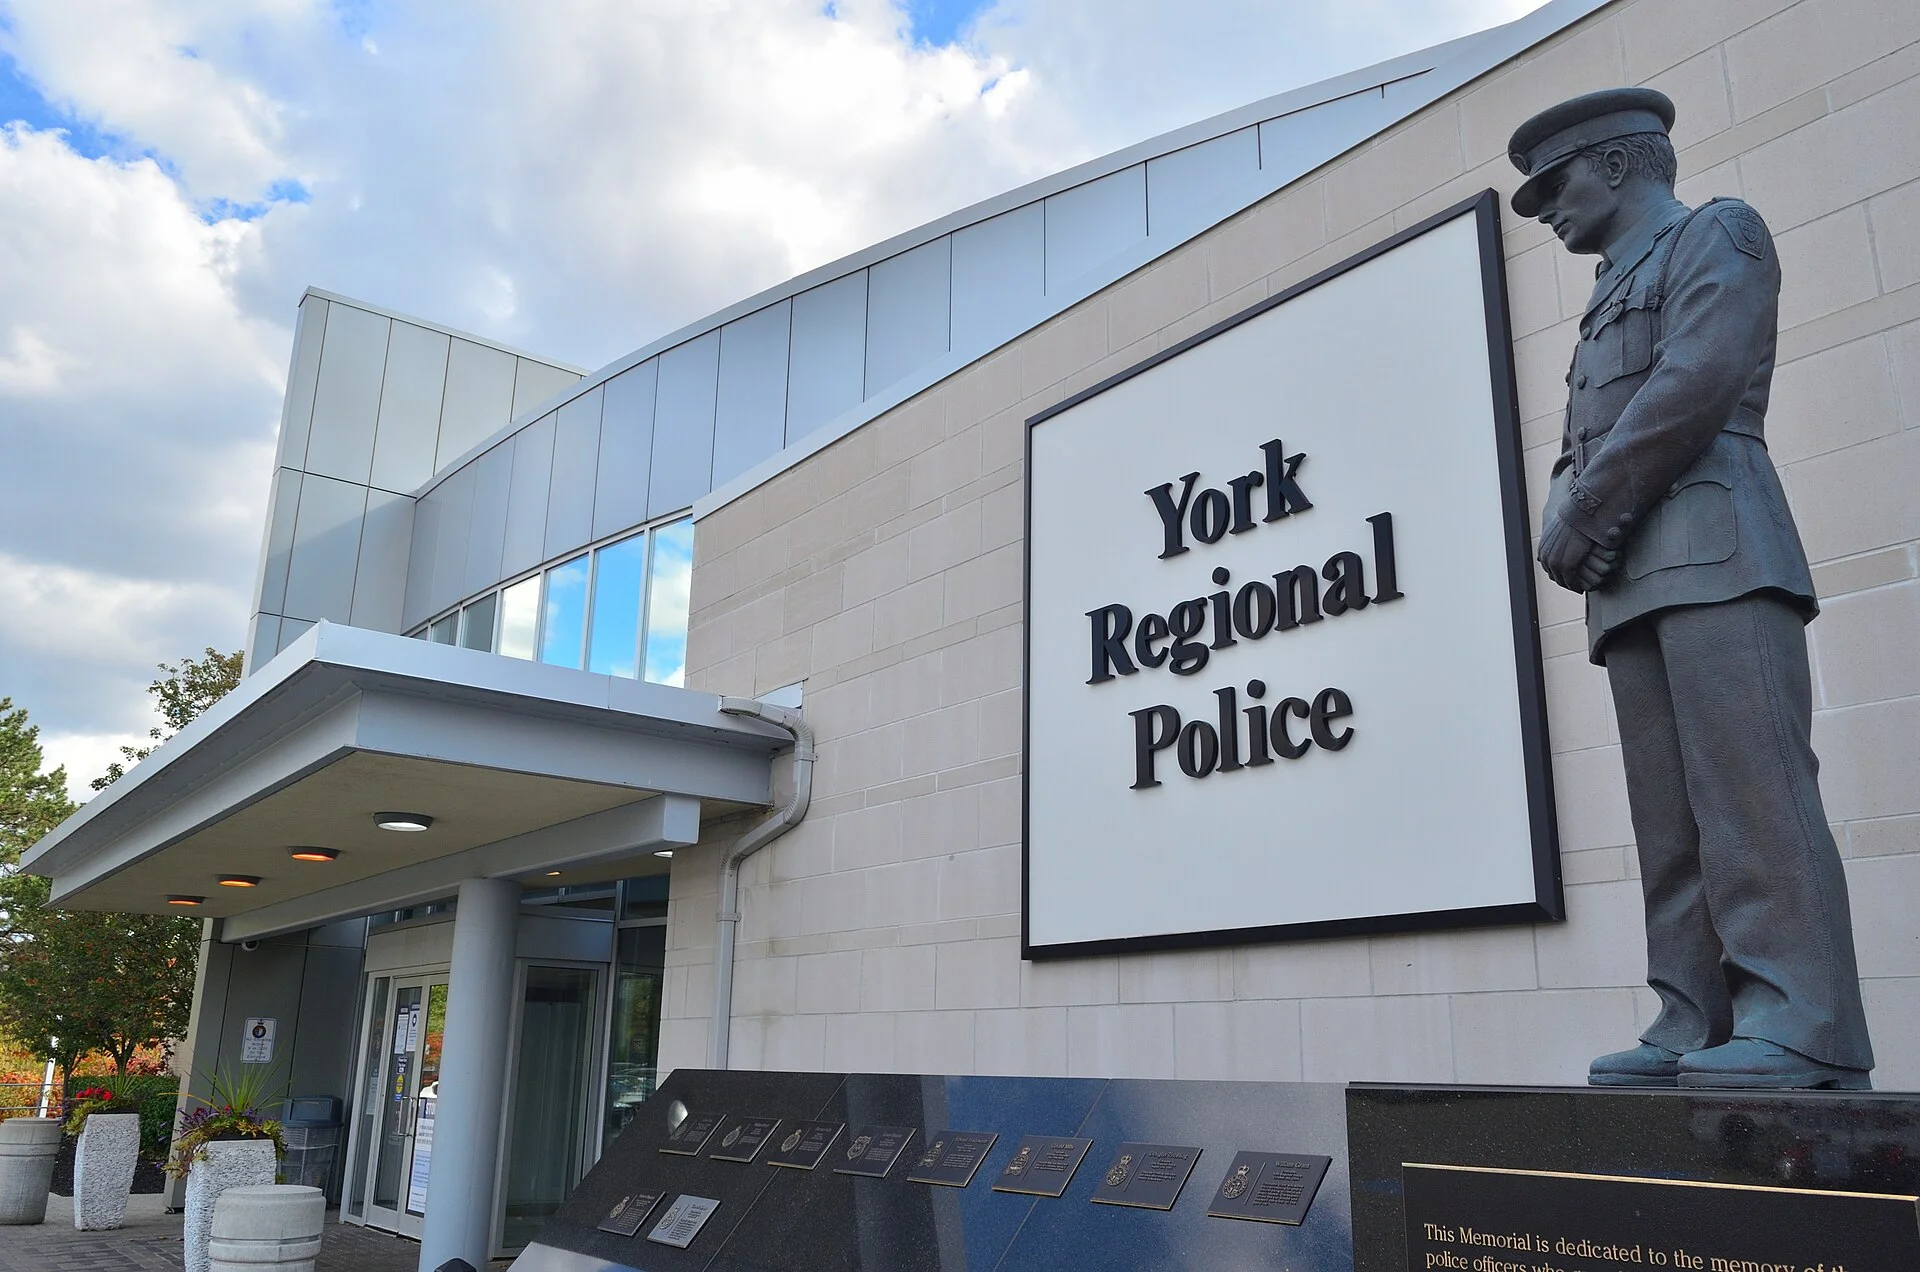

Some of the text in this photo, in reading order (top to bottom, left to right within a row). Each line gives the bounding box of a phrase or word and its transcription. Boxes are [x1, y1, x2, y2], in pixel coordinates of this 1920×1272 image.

[1144, 438, 1313, 560] York
[1084, 511, 1404, 685] Regional
[1128, 679, 1354, 790] Police
[1424, 1222, 1455, 1243] This
[1459, 1226, 1531, 1251] Memorial
[1536, 1235, 1550, 1253] is
[1555, 1237, 1642, 1263] dedicated
[1648, 1248, 1667, 1266] to
[1673, 1249, 1704, 1270] the
[1426, 1250, 1468, 1270] police
[1473, 1255, 1526, 1272] officers
